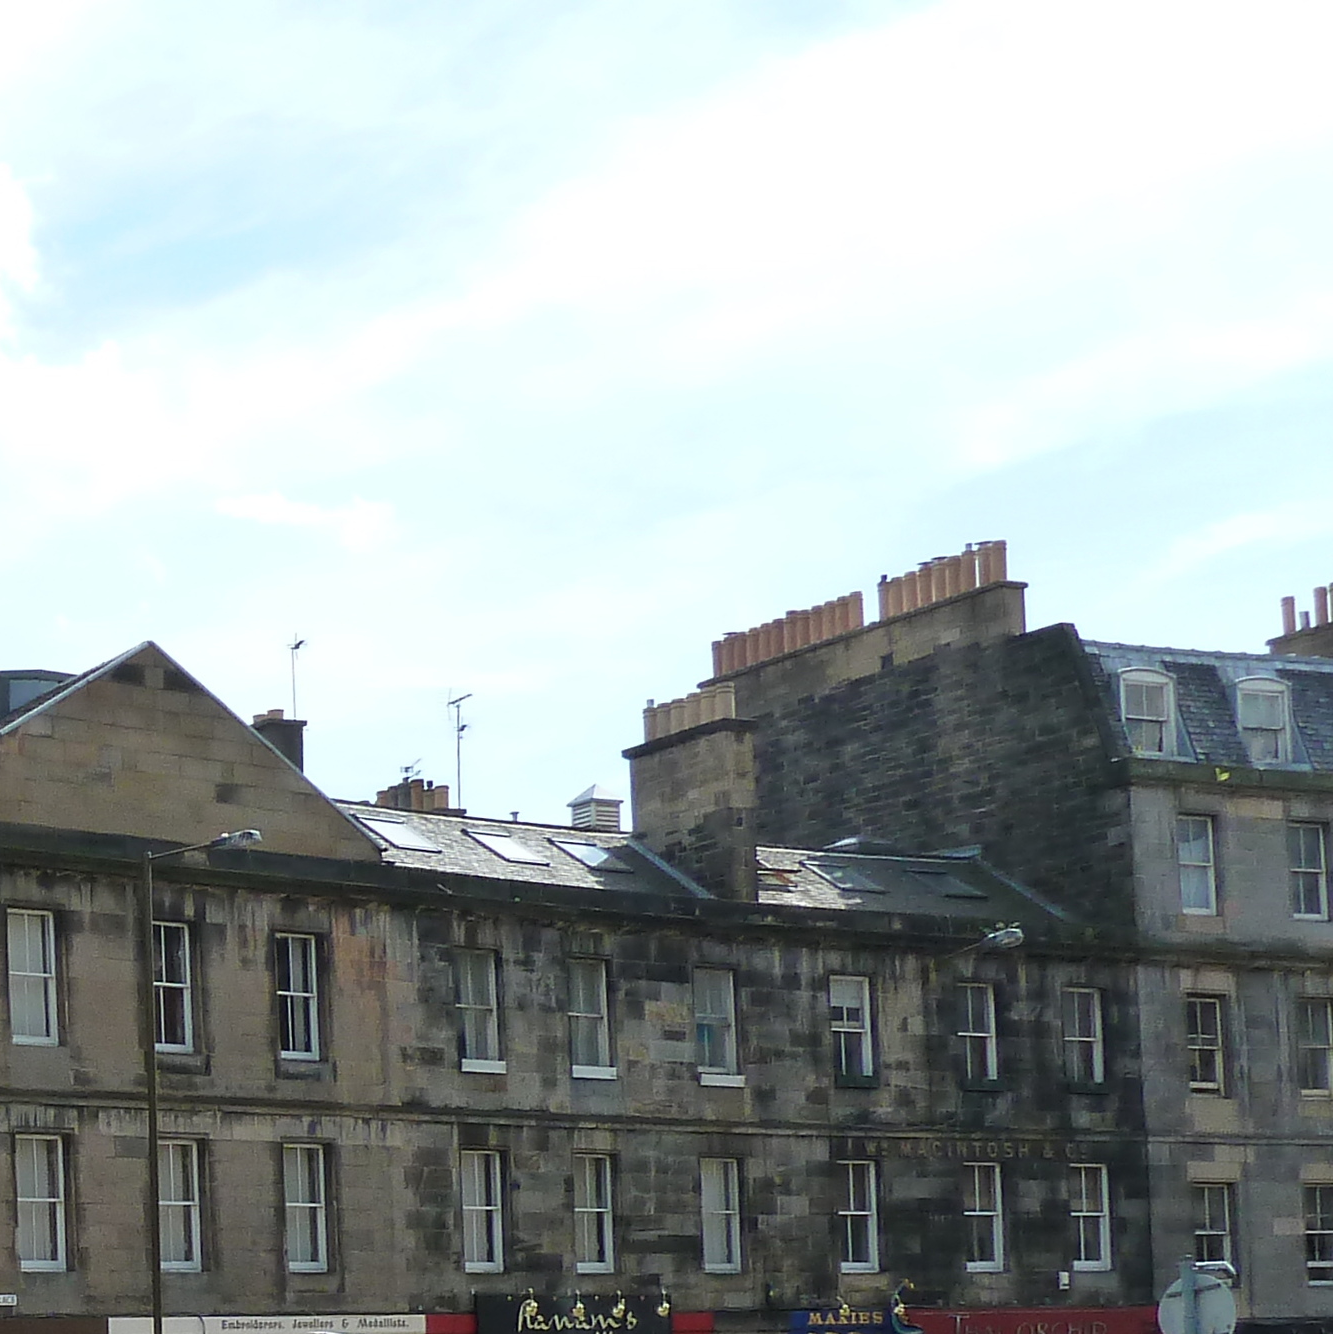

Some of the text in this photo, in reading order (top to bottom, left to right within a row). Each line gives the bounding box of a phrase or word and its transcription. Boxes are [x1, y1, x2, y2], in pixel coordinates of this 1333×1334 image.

[899, 1141, 1030, 1158] MACINTOSH
[292, 1318, 334, 1329] Jewellers
[341, 1318, 350, 1329] &
